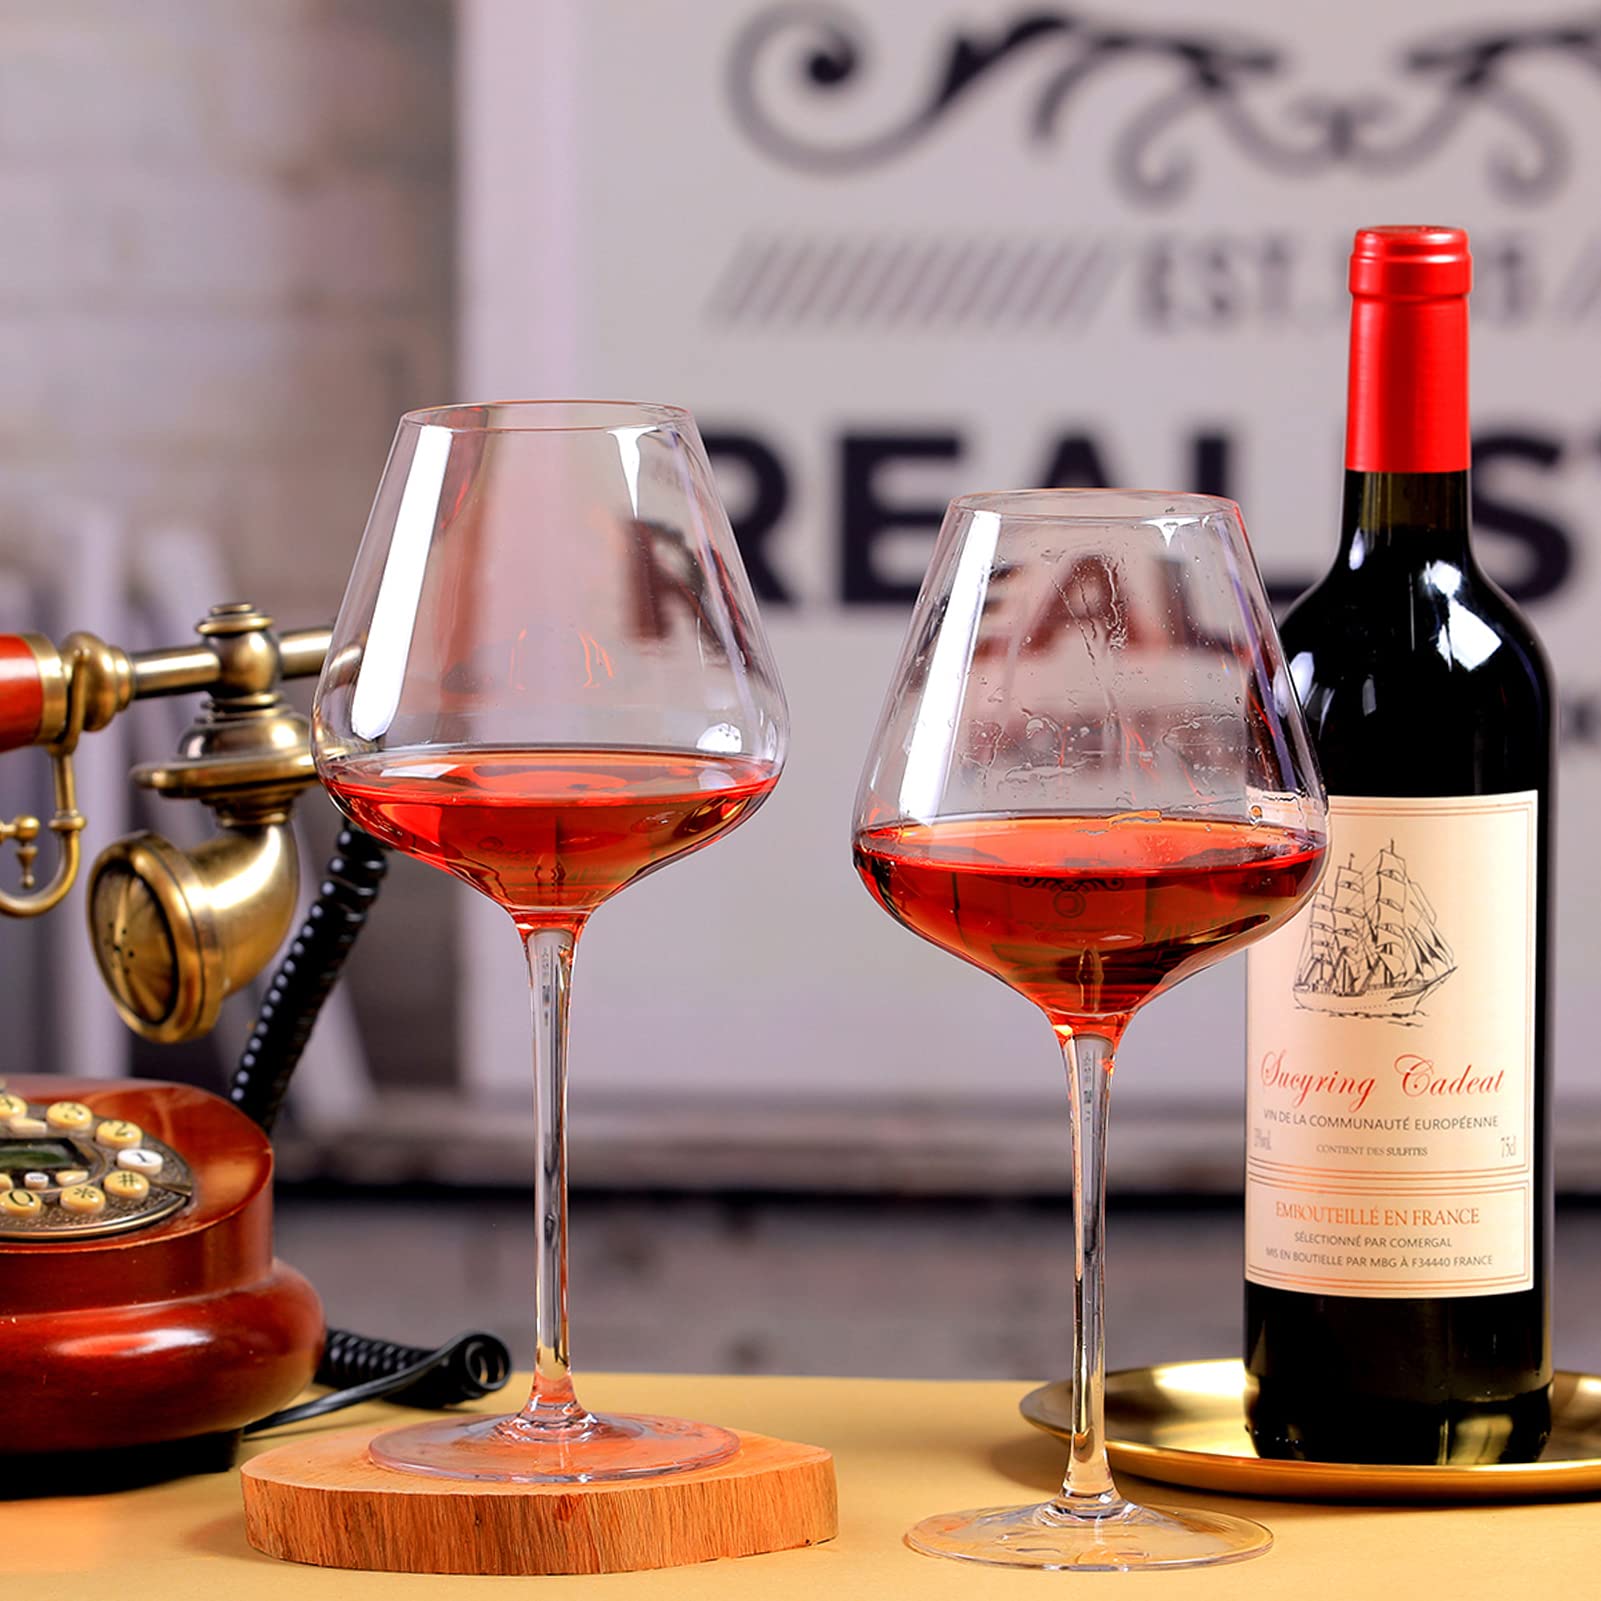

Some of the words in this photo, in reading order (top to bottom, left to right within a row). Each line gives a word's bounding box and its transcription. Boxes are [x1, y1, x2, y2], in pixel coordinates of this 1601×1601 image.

[1263, 1108, 1277, 1121] VIN
[1279, 1110, 1291, 1124] DE
[1293, 1114, 1307, 1126] LA
[1309, 1114, 1411, 1131] COMMUNAUTÉ
[1414, 1114, 1499, 1131] EUROPÉENNE
[1316, 1143, 1365, 1156] CONTIENT
[1367, 1145, 1384, 1156] DES
[1275, 1201, 1380, 1227] EMBOUTEILLÉ
[1384, 1209, 1409, 1227] EN
[1412, 1207, 1481, 1227] FRANCE
[1294, 1231, 1362, 1248] SÉLECTIONNÉ
[1364, 1237, 1387, 1248] PAR
[1389, 1237, 1453, 1249] COMERGAL
[1265, 1246, 1279, 1259] MIS
[1280, 1249, 1292, 1261] EN
[1346, 1256, 1368, 1267] PAR
[1370, 1258, 1398, 1268] MBG
[1453, 1255, 1493, 1267] FRANCE
